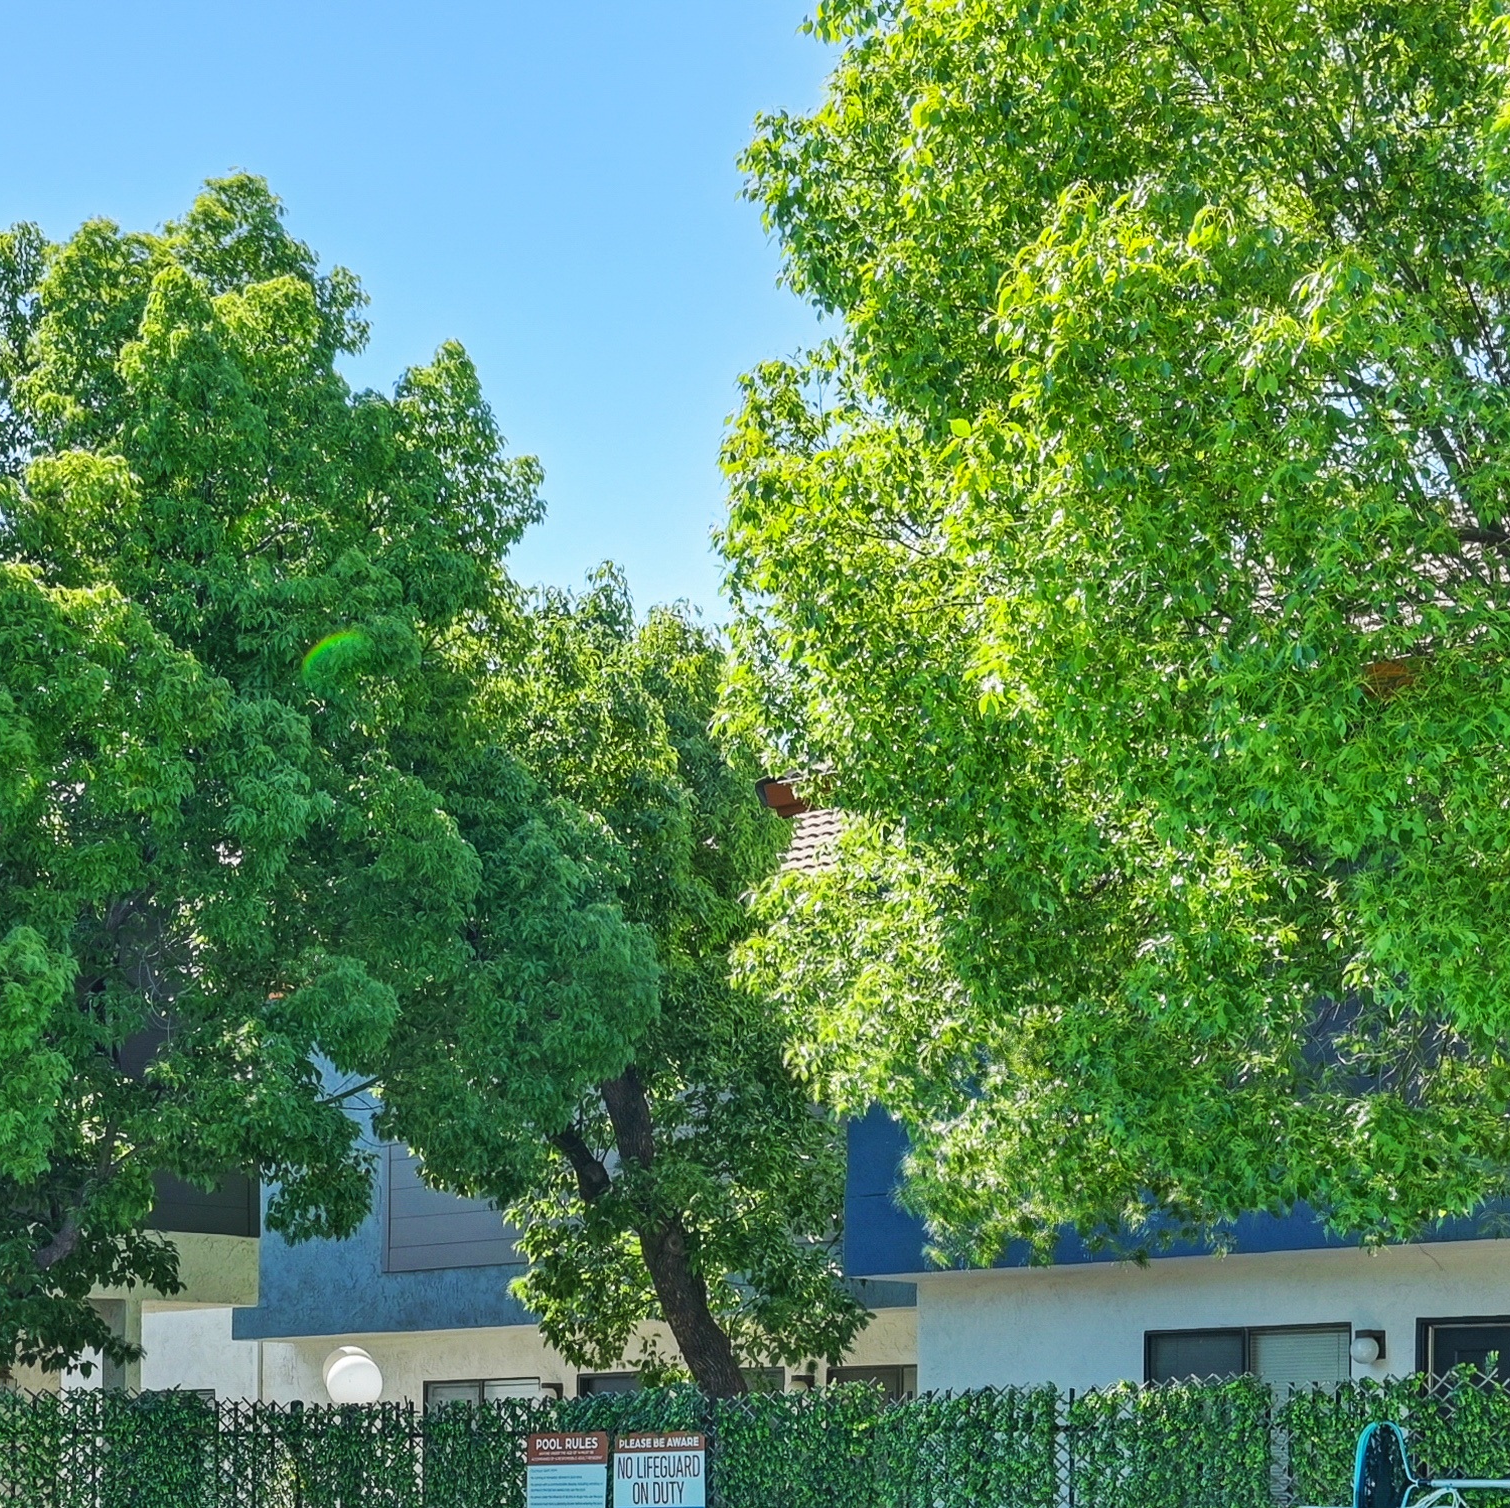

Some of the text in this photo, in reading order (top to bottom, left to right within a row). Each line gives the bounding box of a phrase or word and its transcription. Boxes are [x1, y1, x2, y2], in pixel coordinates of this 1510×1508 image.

[536, 1437, 598, 1450] POOL RULES
[619, 1436, 699, 1448] PLEASE BE AWARE
[617, 1455, 700, 1479] NO LIFEGUARD
[633, 1481, 684, 1504] ON DUTY
